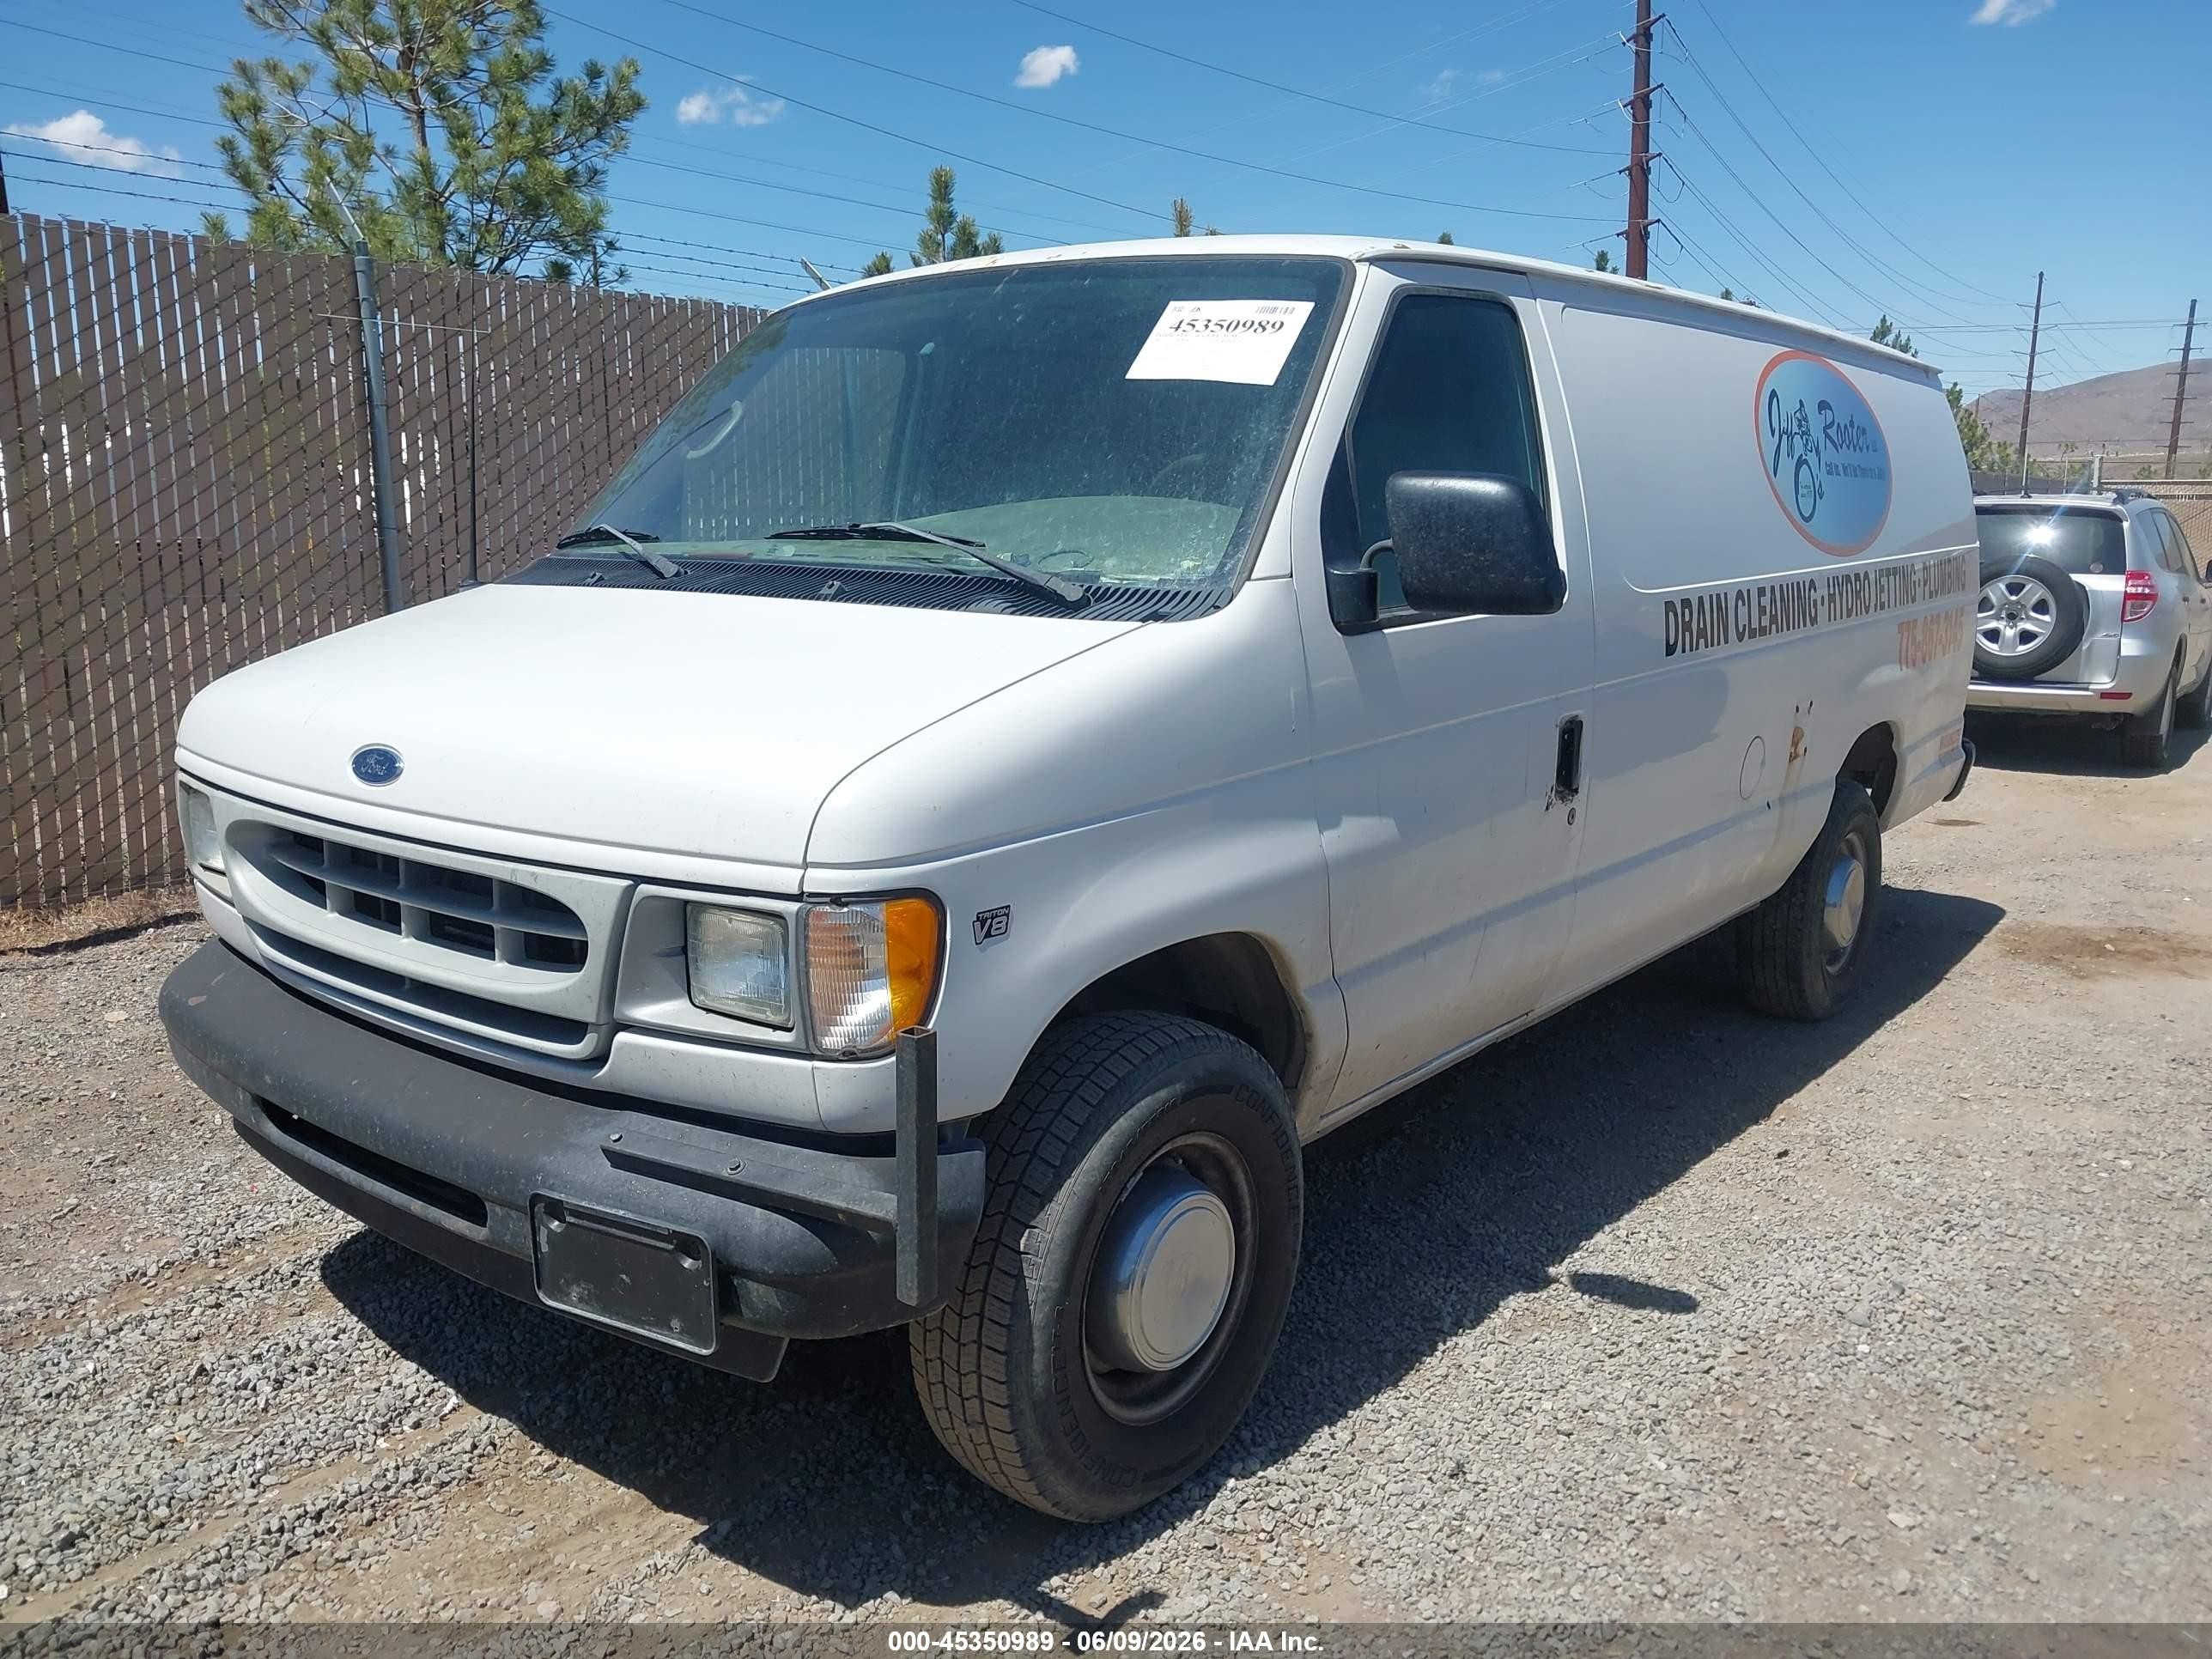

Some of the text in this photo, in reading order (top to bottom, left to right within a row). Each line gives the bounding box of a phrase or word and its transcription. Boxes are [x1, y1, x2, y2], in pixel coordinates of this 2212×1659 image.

[1169, 319, 1285, 334] 45350989
[1817, 399, 1871, 453] Rooter
[1663, 555, 1966, 658] DRAIN CLEANING HYDRO JETTING PLUMBING
[361, 754, 390, 776] Ford
[978, 907, 1010, 921] TRITON
[973, 915, 1008, 944] V8
[1234, 1083, 1301, 1223] CONFIDENCE
